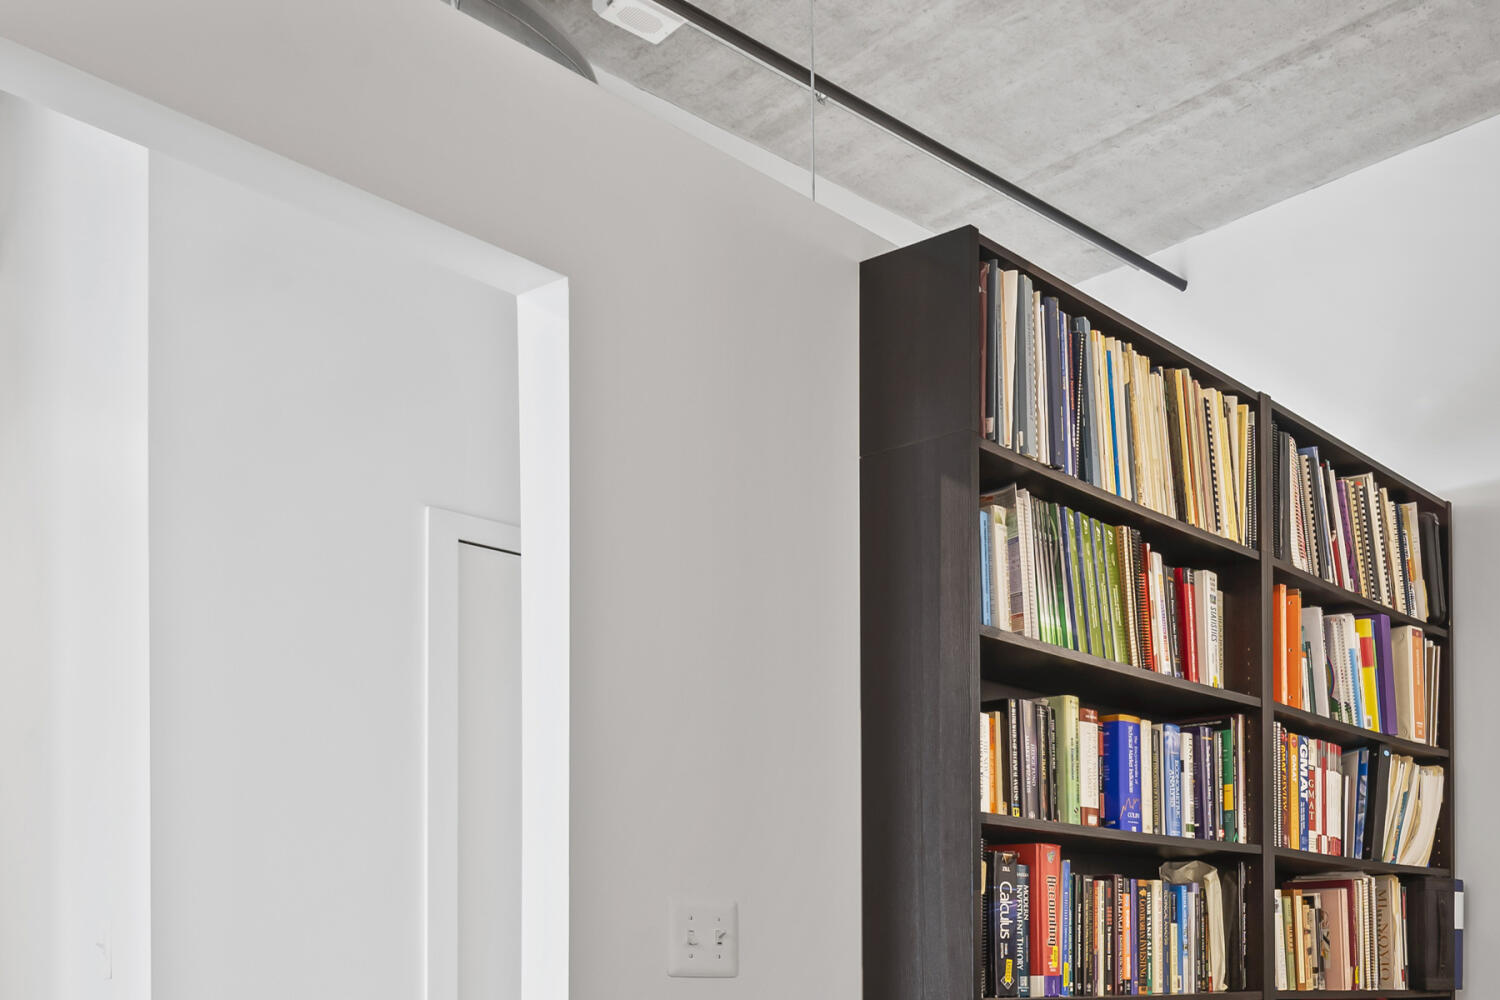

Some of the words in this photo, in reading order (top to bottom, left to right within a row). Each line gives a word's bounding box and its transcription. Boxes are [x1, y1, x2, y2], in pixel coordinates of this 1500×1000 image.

[1210, 605, 1218, 642] STATISTICS
[1299, 744, 1309, 802] GMAT
[999, 880, 1014, 940] Calculus
[1047, 875, 1057, 947] Accounting
[1016, 937, 1024, 971] THEORY
[1139, 939, 1147, 977] INVESTING
